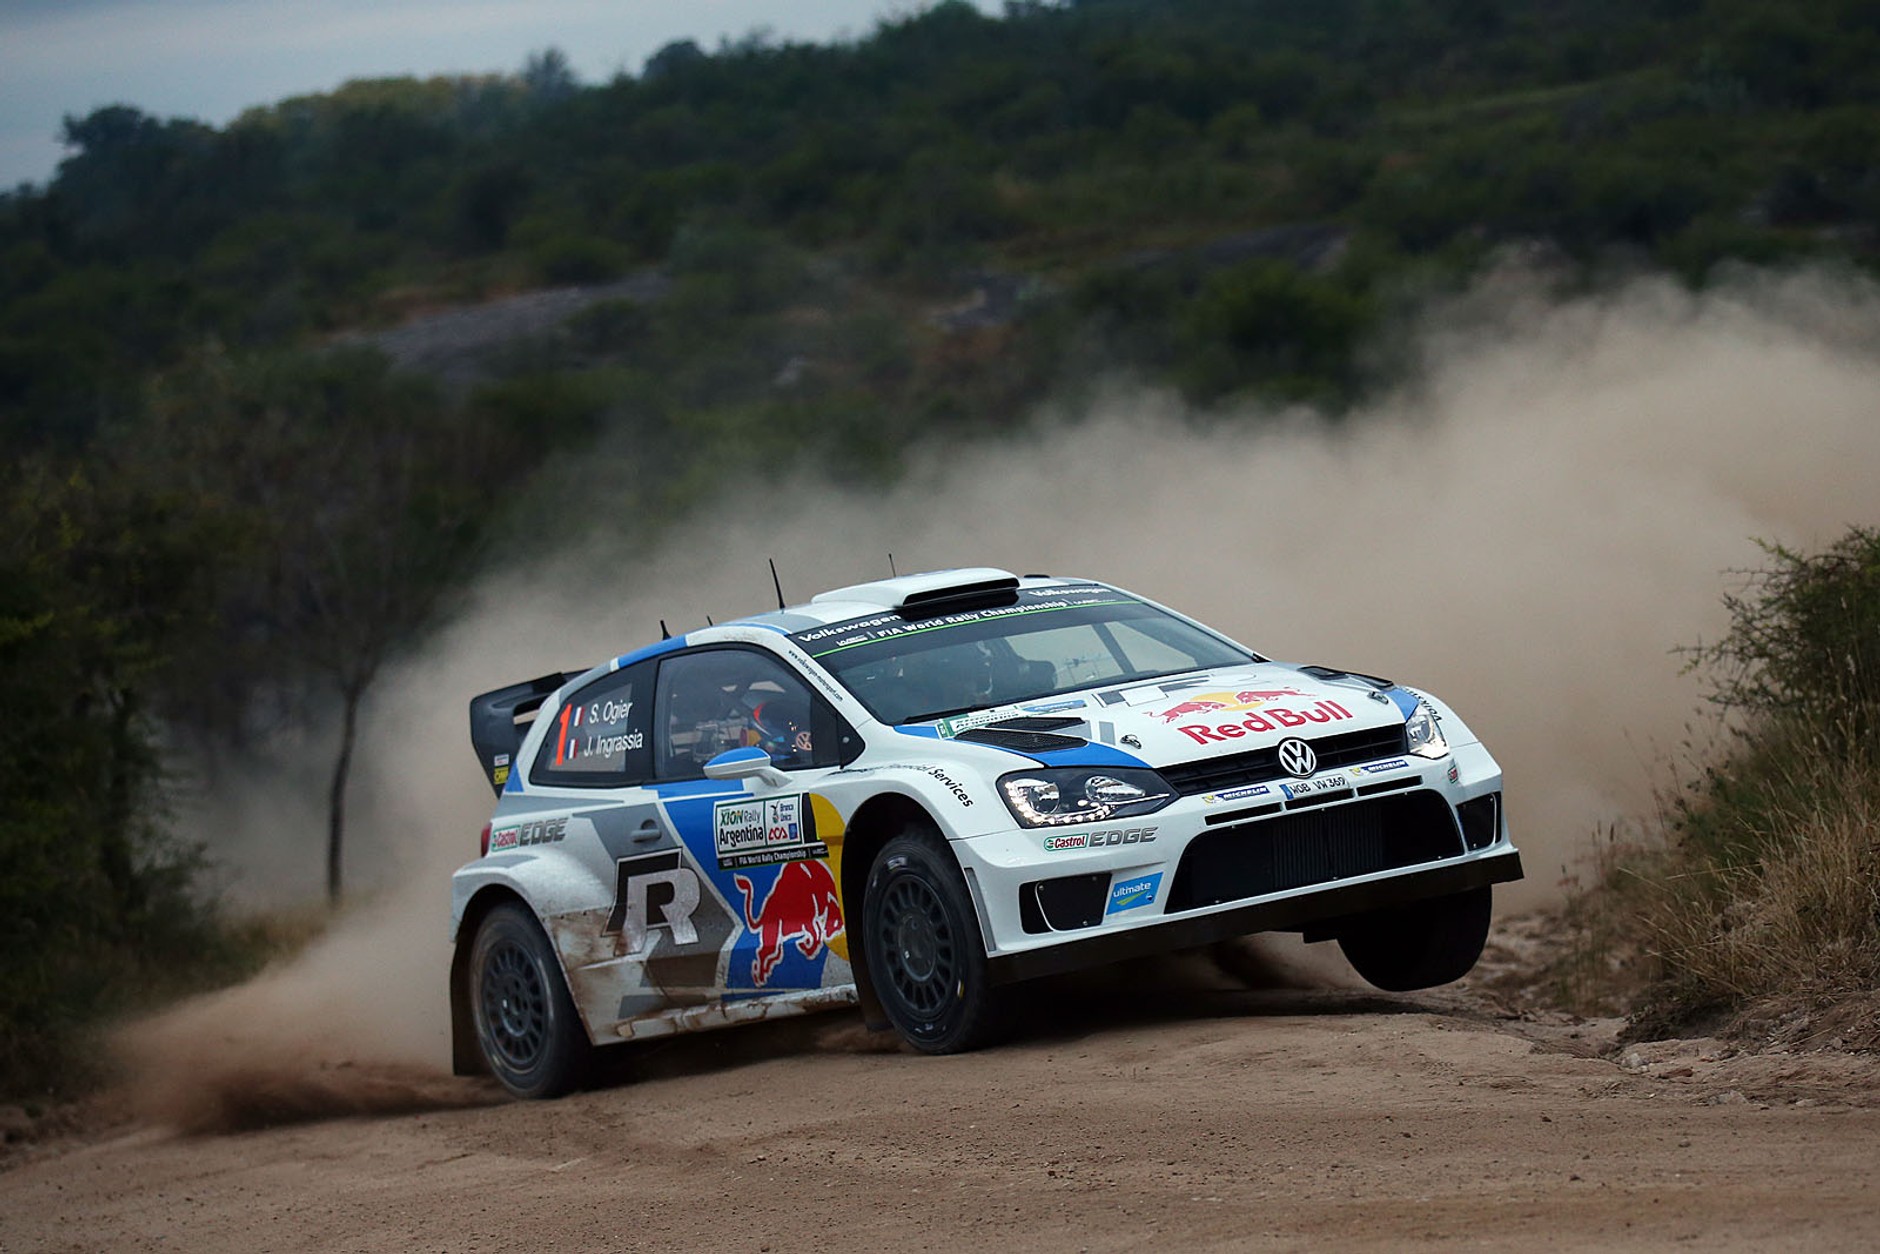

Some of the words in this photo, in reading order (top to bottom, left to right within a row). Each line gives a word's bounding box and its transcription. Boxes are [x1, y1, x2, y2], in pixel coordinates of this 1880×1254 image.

[799, 614, 901, 642] Volkswagen
[877, 627, 903, 638] FIA
[902, 616, 944, 632] World
[945, 612, 979, 625] Rally
[981, 599, 1067, 618] Championship
[589, 703, 599, 724] S.
[602, 700, 633, 725] Ogier
[1177, 712, 1276, 745] Red
[1264, 700, 1353, 728] Bull
[555, 703, 572, 766] 1
[583, 736, 593, 757] J.
[595, 728, 643, 758] Ingrassia
[928, 768, 974, 807] Services
[1223, 787, 1269, 800] MICHELIN
[1290, 783, 1311, 795] WOB
[1327, 776, 1346, 788] 369
[720, 809, 743, 826] XION
[744, 808, 761, 823] Rally
[519, 817, 569, 847] EDGE
[719, 824, 764, 847] Argentina
[1054, 836, 1085, 849] Castrol
[1089, 827, 1159, 847] EDGE
[1113, 881, 1152, 898] ultimate
[613, 867, 701, 956] R
